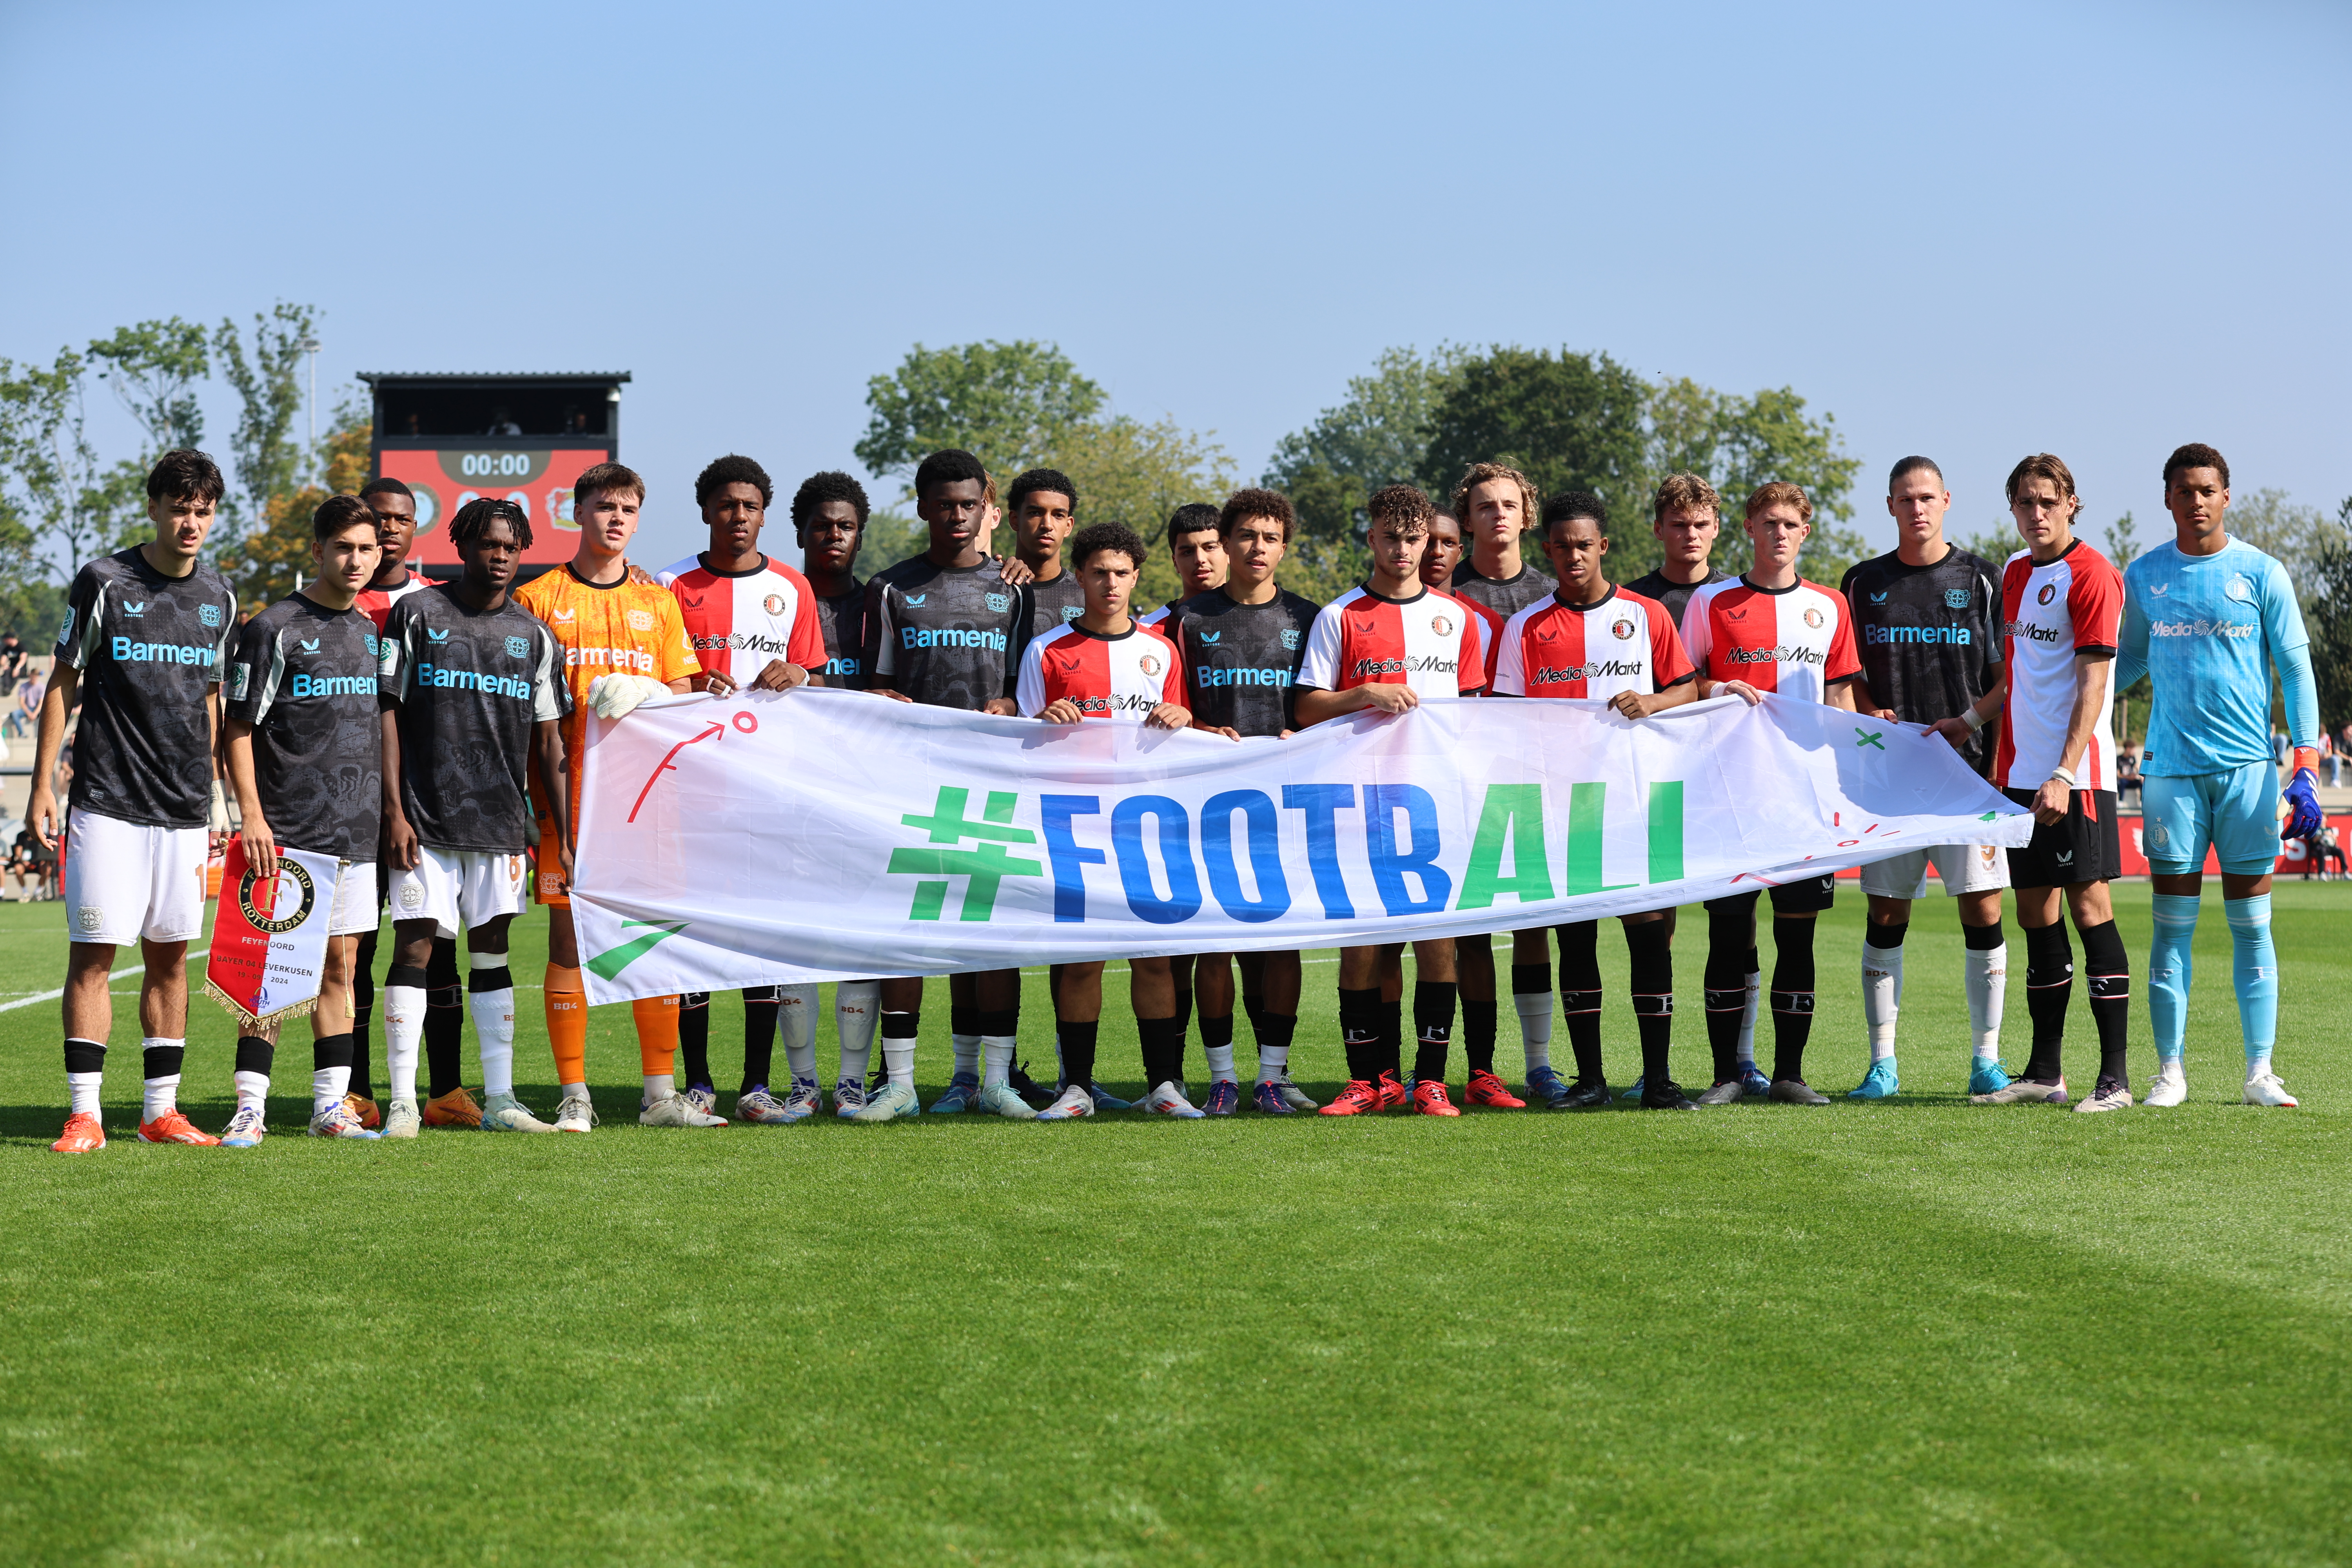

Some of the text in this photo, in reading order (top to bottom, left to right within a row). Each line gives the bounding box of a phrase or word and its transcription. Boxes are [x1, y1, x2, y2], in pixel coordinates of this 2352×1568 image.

[461, 454, 530, 476] 00:00
[765, 594, 784, 603] FEYENOORD
[764, 606, 784, 615] ROTTERDAM
[1614, 631, 1633, 639] ROTTERDAM
[1865, 622, 1971, 645] Barmenia
[2021, 622, 2059, 642] Markt
[2149, 620, 2254, 637] Media Markt
[742, 634, 785, 654] Markt
[901, 627, 1007, 652] Barmenia
[558, 644, 653, 672] Barmenia
[1724, 646, 1824, 665] Media Markt
[1350, 656, 1457, 679] Media Markt
[1530, 660, 1642, 686] Media Markt
[293, 672, 377, 697] Barmeni
[418, 663, 530, 700] Barmenia
[1121, 694, 1162, 712] Mark
[248, 858, 311, 889] FNOORD
[242, 902, 308, 931] ROTTERDAM
[241, 936, 294, 951] FEYENOORD
[217, 955, 243, 965] BAYER
[258, 962, 312, 976] LEVERKUSEN
[248, 998, 270, 1006] YOUTH
